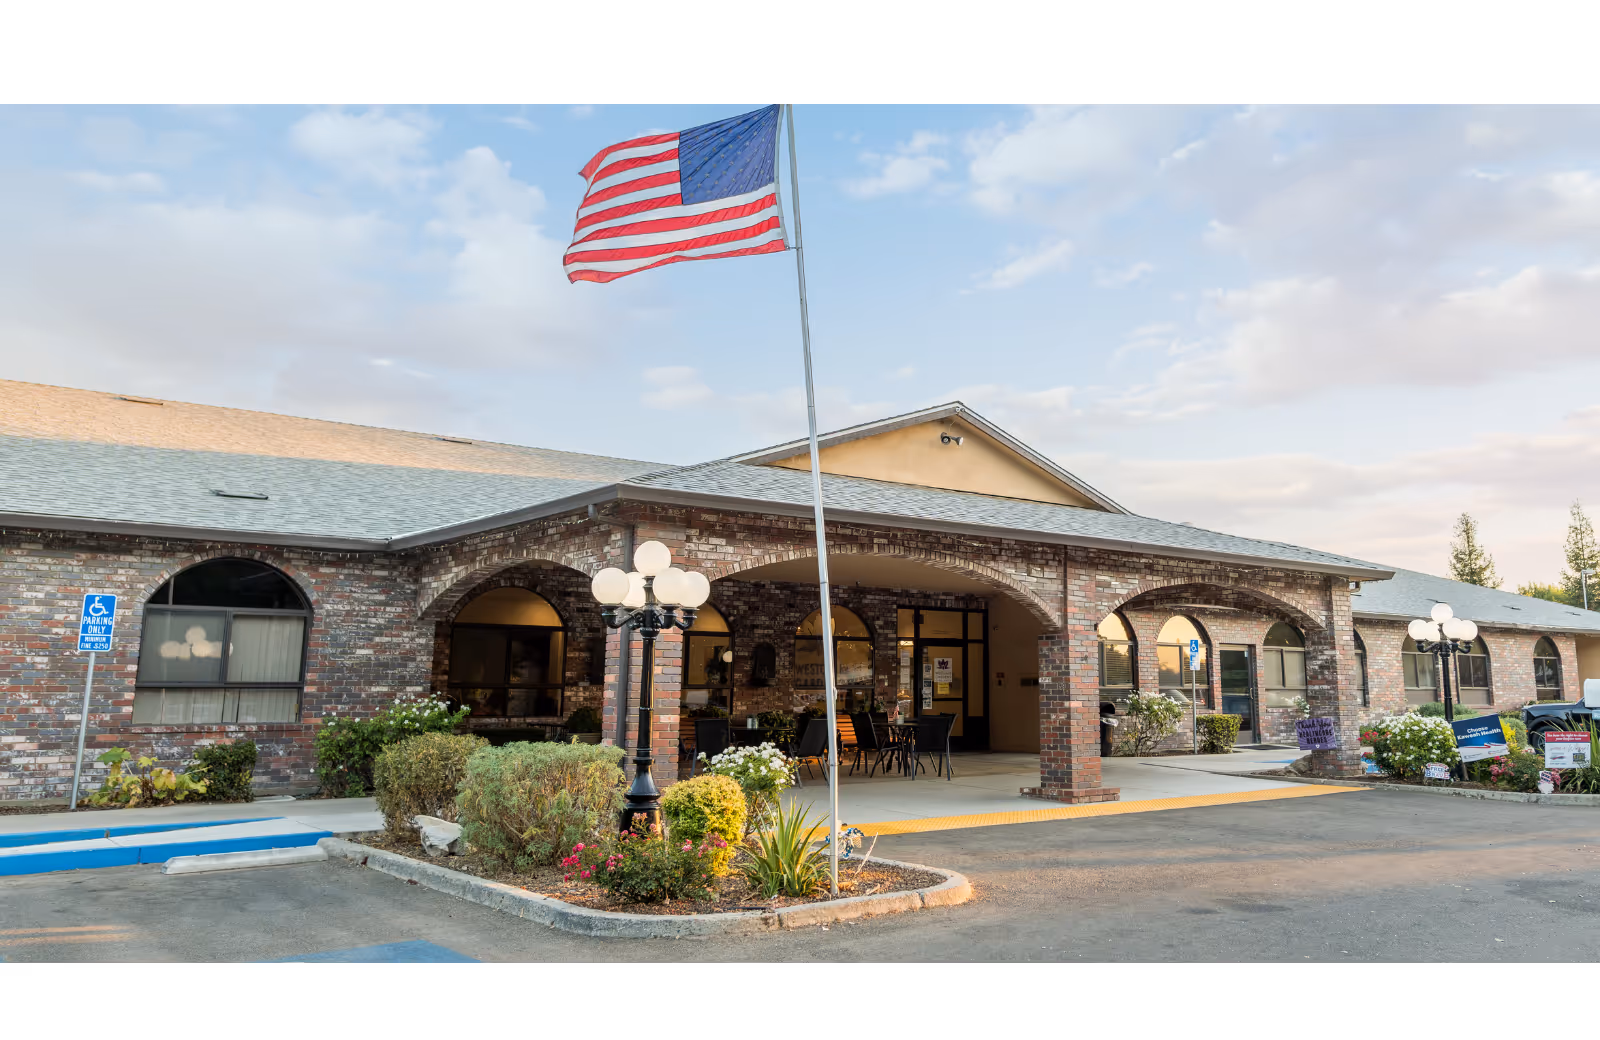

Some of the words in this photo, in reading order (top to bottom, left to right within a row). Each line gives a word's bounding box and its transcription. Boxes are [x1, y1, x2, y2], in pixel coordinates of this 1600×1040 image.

[83, 616, 113, 625] PARKING
[88, 625, 106, 634] ONLY
[1457, 731, 1481, 740] Kaweah
[1481, 727, 1502, 736] Health
[1467, 726, 1489, 734] Choose
